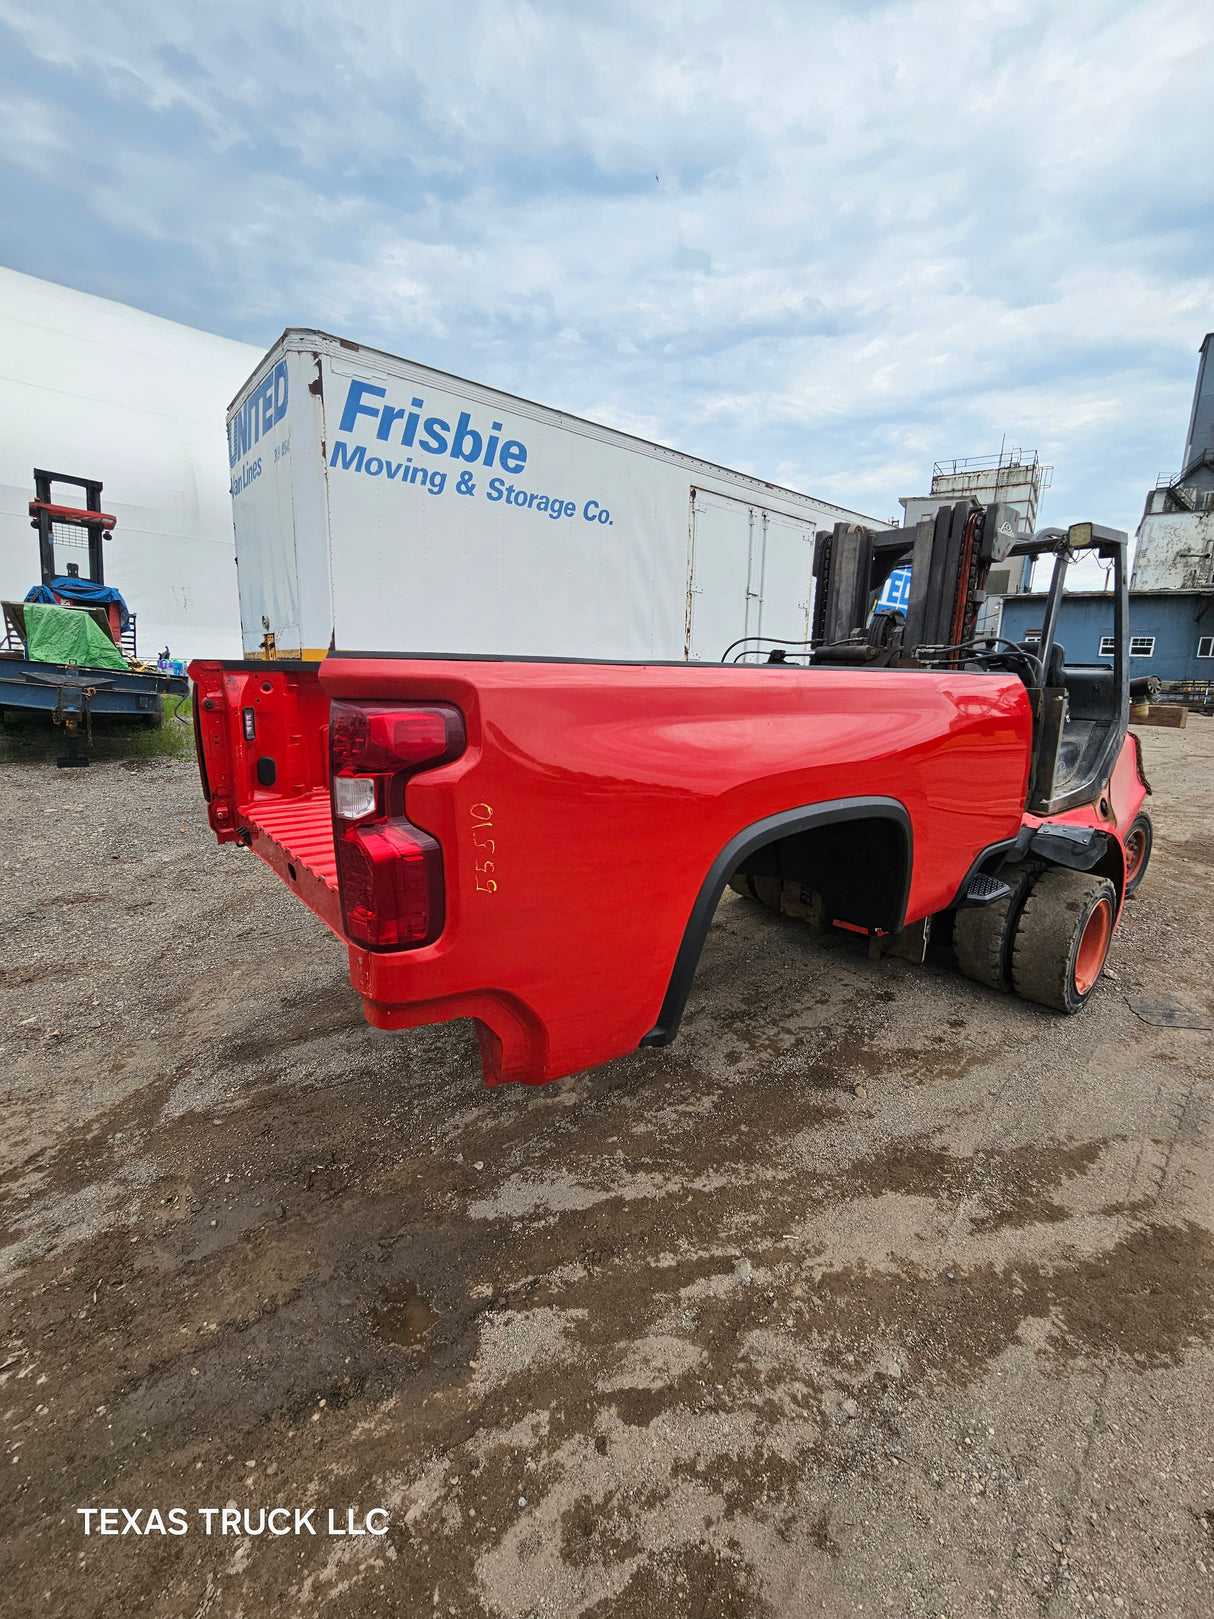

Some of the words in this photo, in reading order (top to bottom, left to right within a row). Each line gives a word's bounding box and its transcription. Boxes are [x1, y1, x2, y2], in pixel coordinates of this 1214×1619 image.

[228, 360, 289, 469] UNITED
[338, 379, 528, 475] Frisbie
[243, 457, 262, 489] Lines
[329, 440, 448, 496] Moving
[455, 470, 476, 497] &
[486, 477, 577, 520] Storage
[582, 500, 615, 526] Co.
